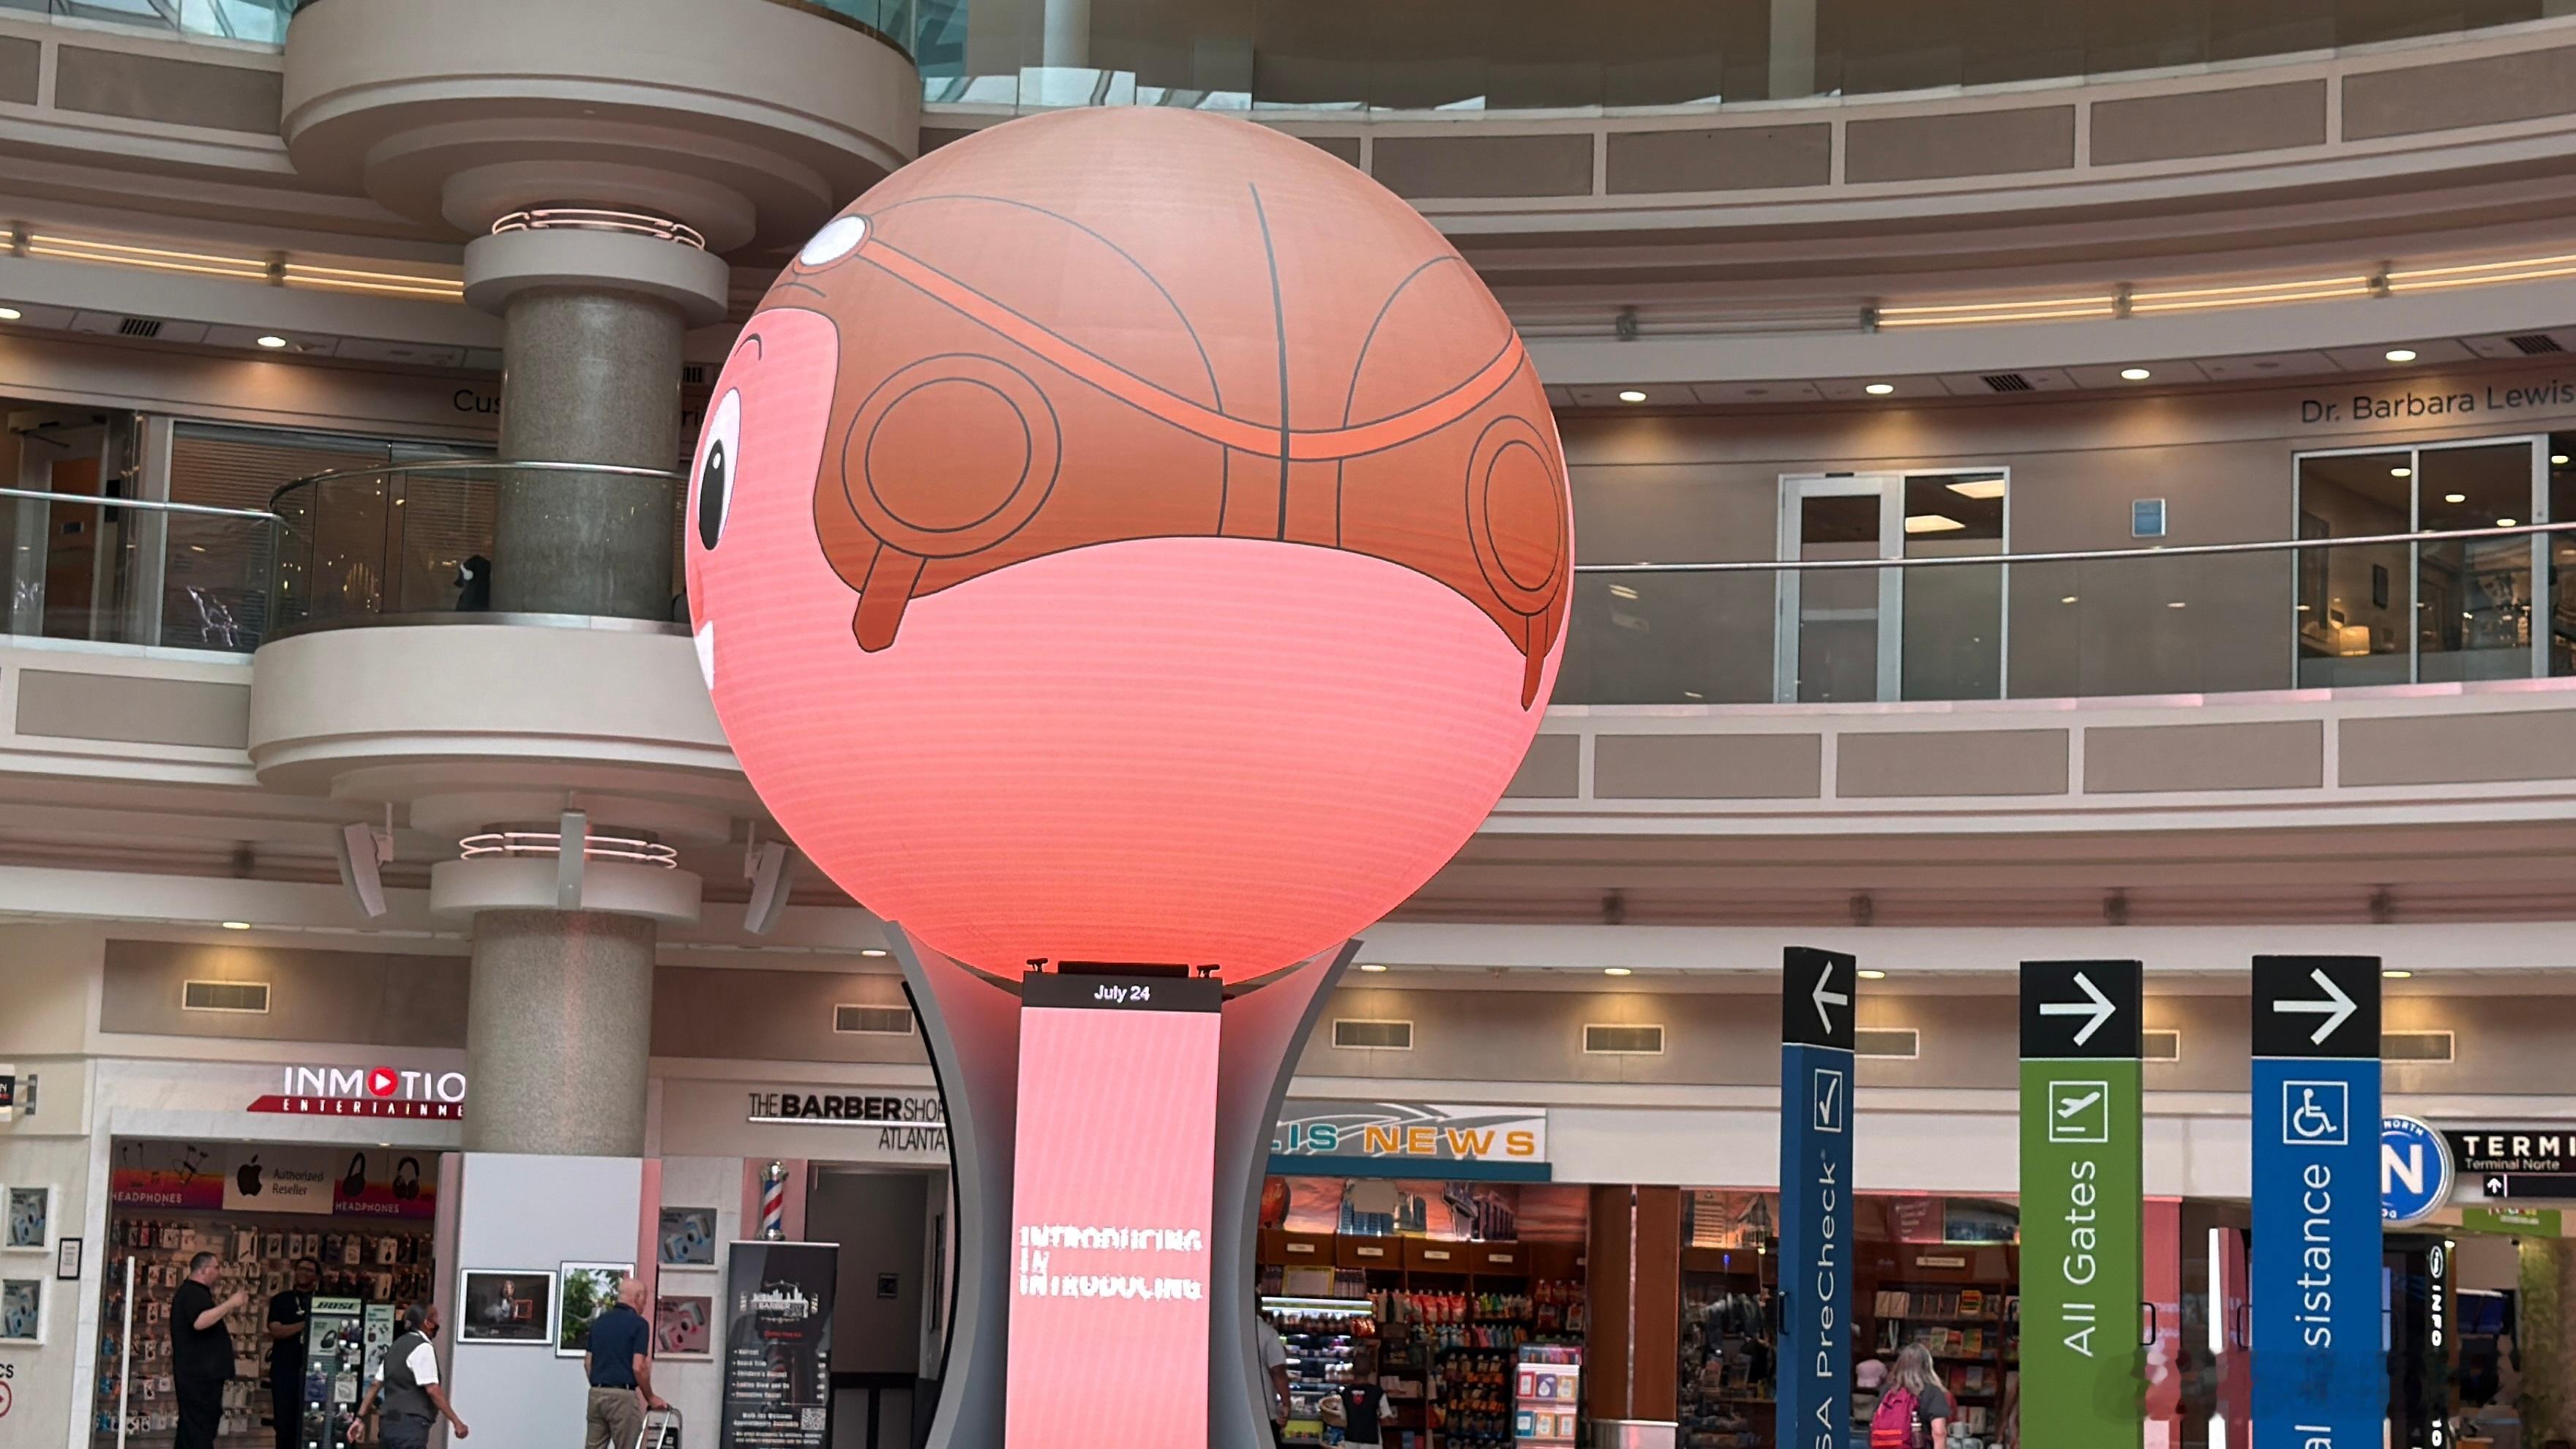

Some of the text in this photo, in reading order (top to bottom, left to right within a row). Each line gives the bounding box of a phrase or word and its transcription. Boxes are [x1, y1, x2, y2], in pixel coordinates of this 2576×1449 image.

[2301, 400, 2340, 423] Dr.
[2352, 392, 2474, 420] Barbara
[1094, 984, 1150, 1003] July 24
[879, 1127, 946, 1150] ATLANTA
[1364, 1125, 1535, 1157] NEWS
[2384, 1120, 2424, 1136] NORTH
[273, 1168, 323, 1183] Authorized
[2381, 1144, 2424, 1194] N
[2465, 1158, 2560, 1171] Terminal Norte
[272, 1183, 308, 1196] Reseller
[335, 1201, 400, 1213] HEADPHONES
[1816, 1162, 1835, 1377] PreCheck
[2062, 1161, 2096, 1358] All Gates
[2295, 1164, 2331, 1348] sistance
[2432, 1285, 2442, 1347] INFO
